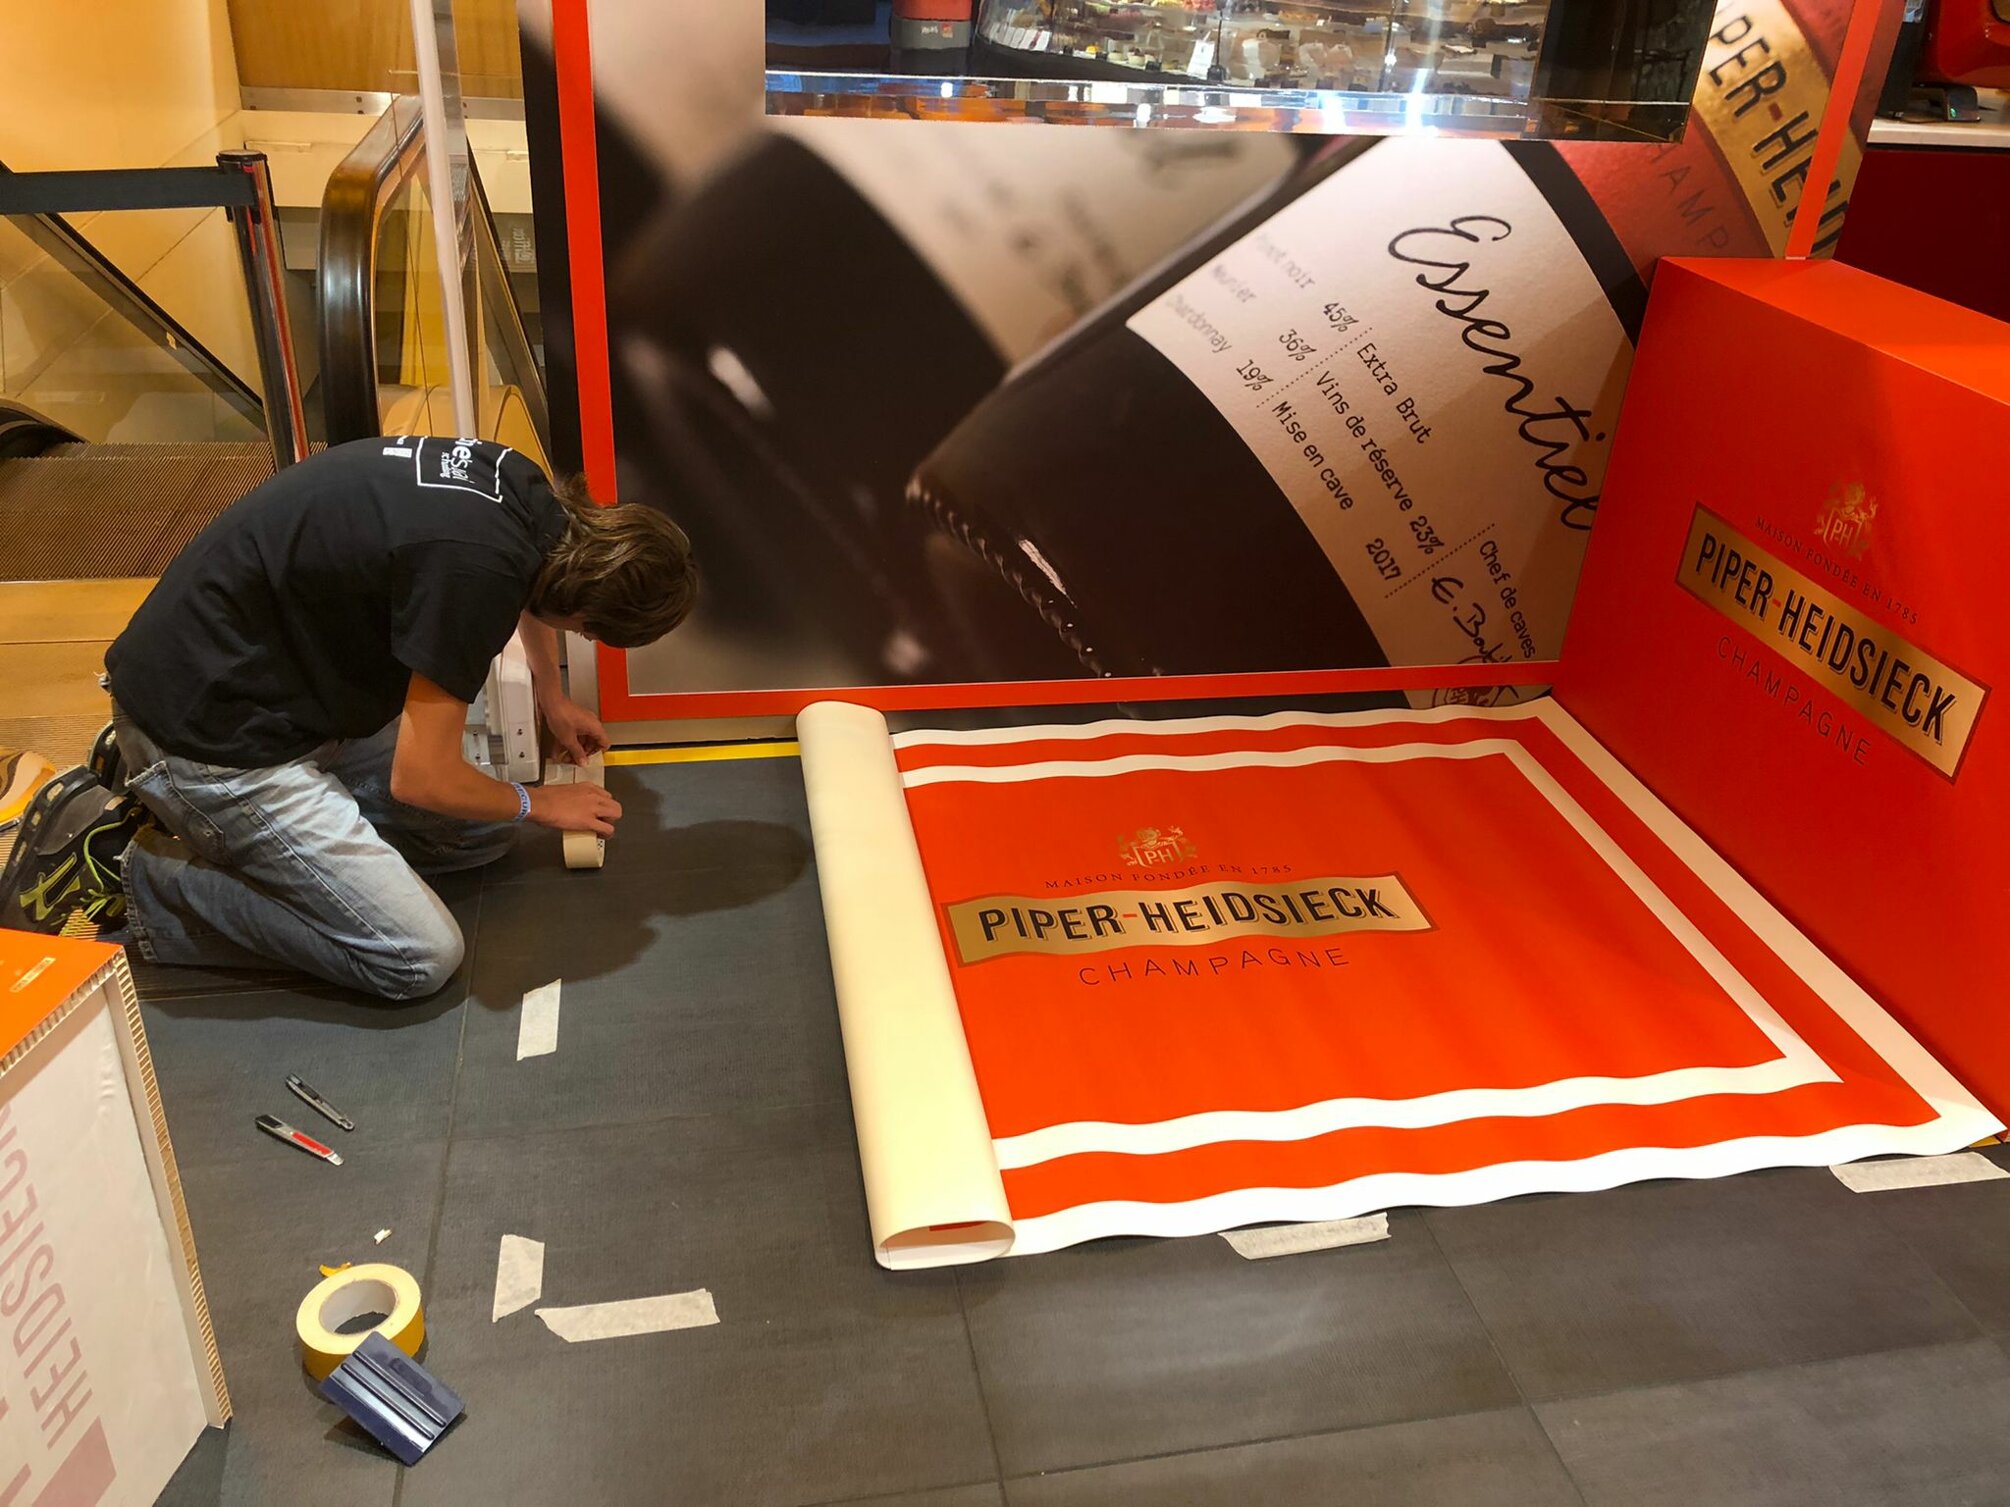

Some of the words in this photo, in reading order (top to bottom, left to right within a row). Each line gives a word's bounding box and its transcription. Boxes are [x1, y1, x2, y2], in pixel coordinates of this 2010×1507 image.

[1279, 329, 1317, 361] 36%
[1286, 261, 1315, 288] noir
[1323, 302, 1359, 332] 45%
[1236, 359, 1274, 391] 19%
[1357, 343, 1398, 395] Extra
[1396, 397, 1432, 443] Brut
[1272, 401, 1307, 443] Mise
[1304, 445, 1324, 467] en
[1320, 468, 1353, 509] cave
[1366, 538, 1401, 580] 2017
[1317, 371, 1349, 414] Vins
[1345, 416, 1366, 438] de
[1361, 439, 1413, 511] réserve
[1410, 516, 1445, 554] 23%
[1480, 541, 1511, 584] Chef
[1500, 587, 1517, 608] de
[1510, 611, 1535, 658] caves
[1756, 517, 1803, 552] MAISON
[1863, 584, 1881, 600] EN
[1886, 598, 1917, 624] 1785
[1696, 533, 1956, 744] PIPER-HEIDSIECK
[1717, 636, 1872, 767] CHAMPAGNE
[978, 887, 1398, 941] PIPER-HEIDSIECK
[1045, 873, 1123, 888] MAISON
[1133, 864, 1211, 881] FONDÉE
[1218, 864, 1242, 873] EN
[1251, 865, 1292, 875] 1785
[1078, 947, 1349, 986] CHAMPAGNE
